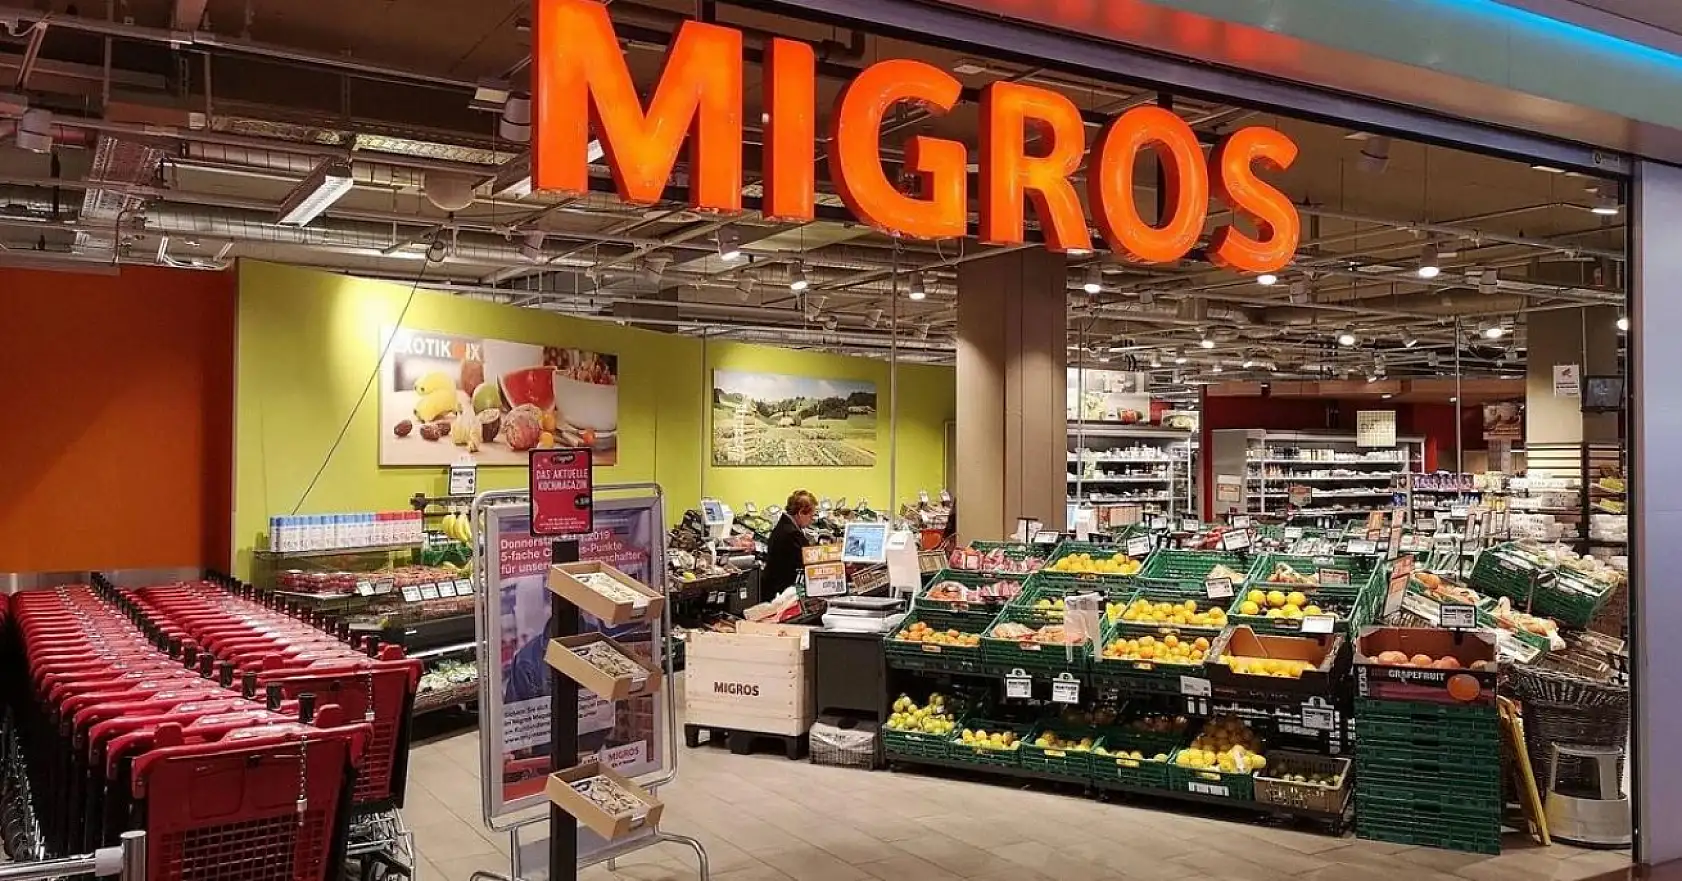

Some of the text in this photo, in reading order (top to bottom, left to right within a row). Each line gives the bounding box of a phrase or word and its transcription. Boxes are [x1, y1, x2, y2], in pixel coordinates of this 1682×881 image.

[531, 0, 1300, 273] MIGROS
[501, 549, 540, 562] 5-fache
[501, 563, 516, 575] für
[1388, 669, 1446, 682] GRAPEFRUIT
[714, 681, 760, 697] MIGROS
[608, 746, 640, 762] MIGROS
